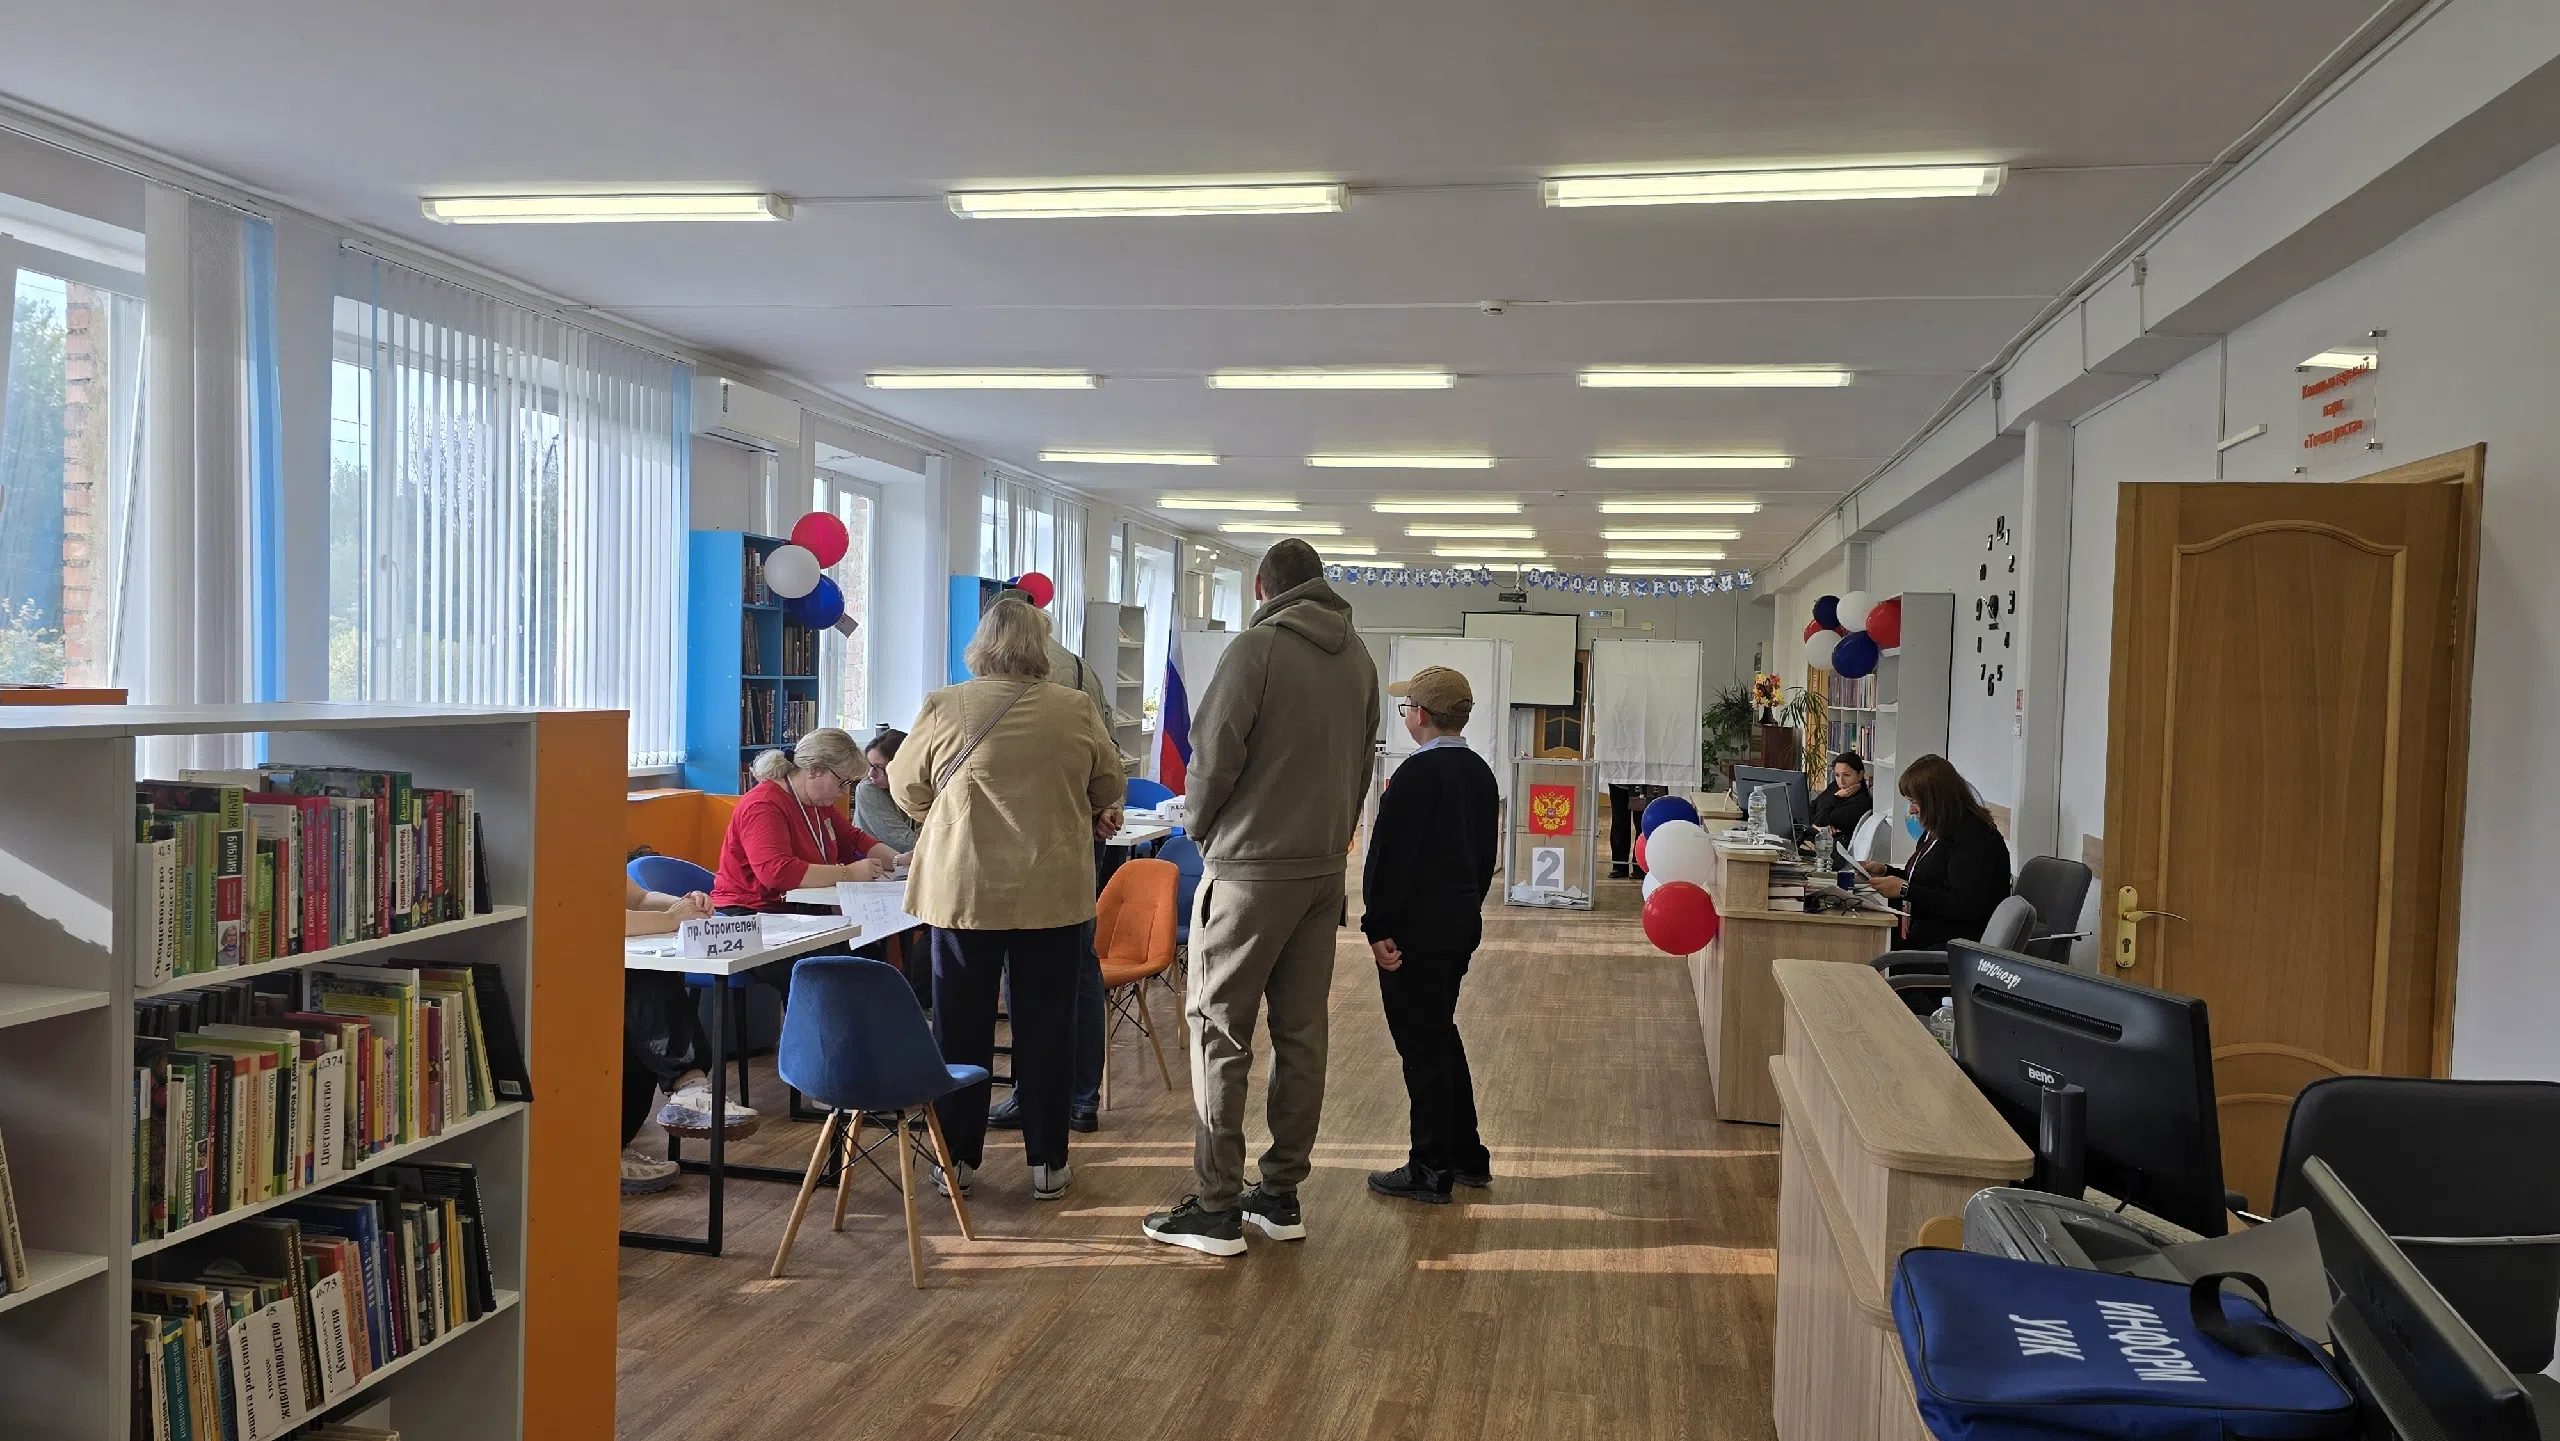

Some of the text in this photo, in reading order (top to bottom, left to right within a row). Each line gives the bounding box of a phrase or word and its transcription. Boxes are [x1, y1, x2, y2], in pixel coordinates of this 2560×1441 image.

[2323, 399, 2344, 417] парк
[1652, 569, 1754, 597] РОССИИ
[228, 790, 239, 829] ДАЧНАЯ
[226, 835, 237, 873] БИБЛИЯ
[1534, 850, 1560, 888] 2
[154, 865, 165, 978] Овощеводство
[686, 916, 760, 938] пр. Строителей,
[706, 938, 744, 957] д.24
[267, 1073, 276, 1103] ОГОРОД
[320, 1080, 331, 1166] Цветоводство
[331, 1308, 347, 1373] Кинология
[2007, 1312, 2086, 1362] УИК
[2094, 1299, 2208, 1384] ИНФОРМ
[239, 1336, 254, 1392] растений
